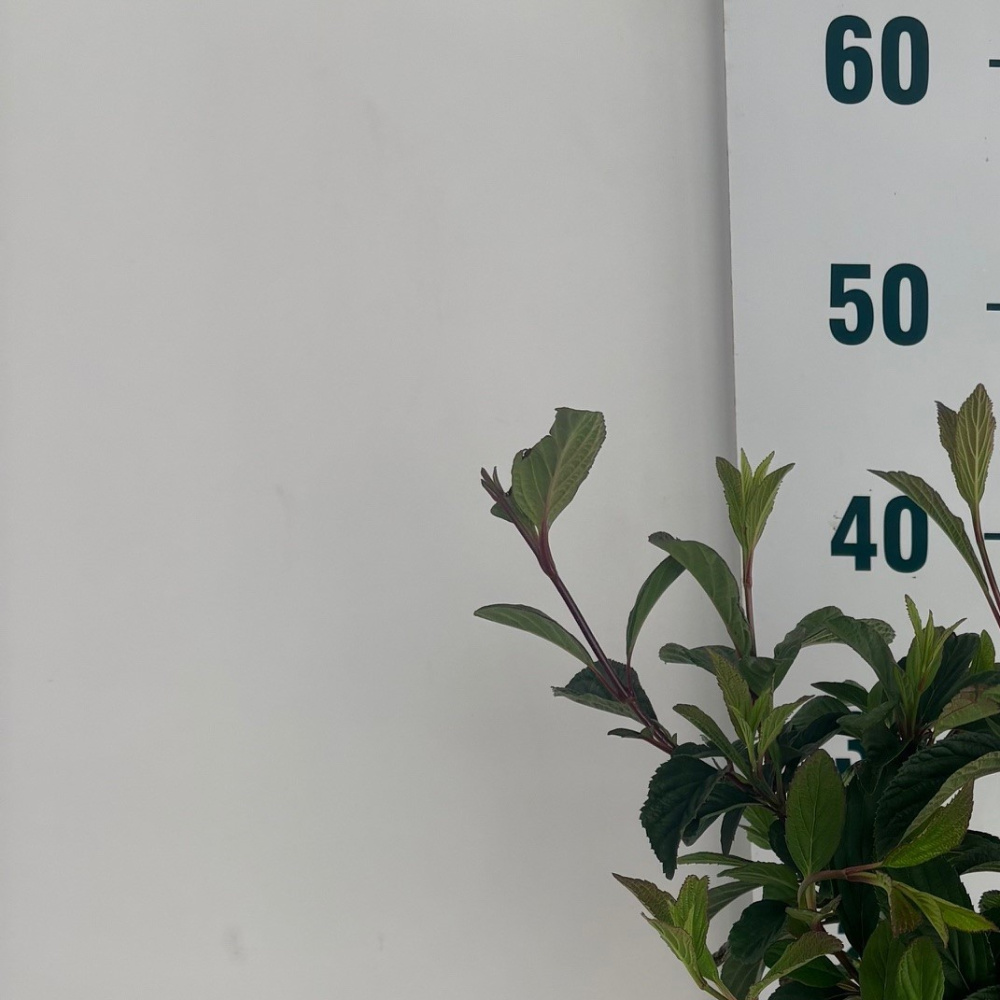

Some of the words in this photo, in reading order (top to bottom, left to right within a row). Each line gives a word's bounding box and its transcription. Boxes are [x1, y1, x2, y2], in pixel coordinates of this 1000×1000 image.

[826, 15, 929, 105] 60
[829, 263, 928, 346] 50
[831, 495, 928, 573] 40
